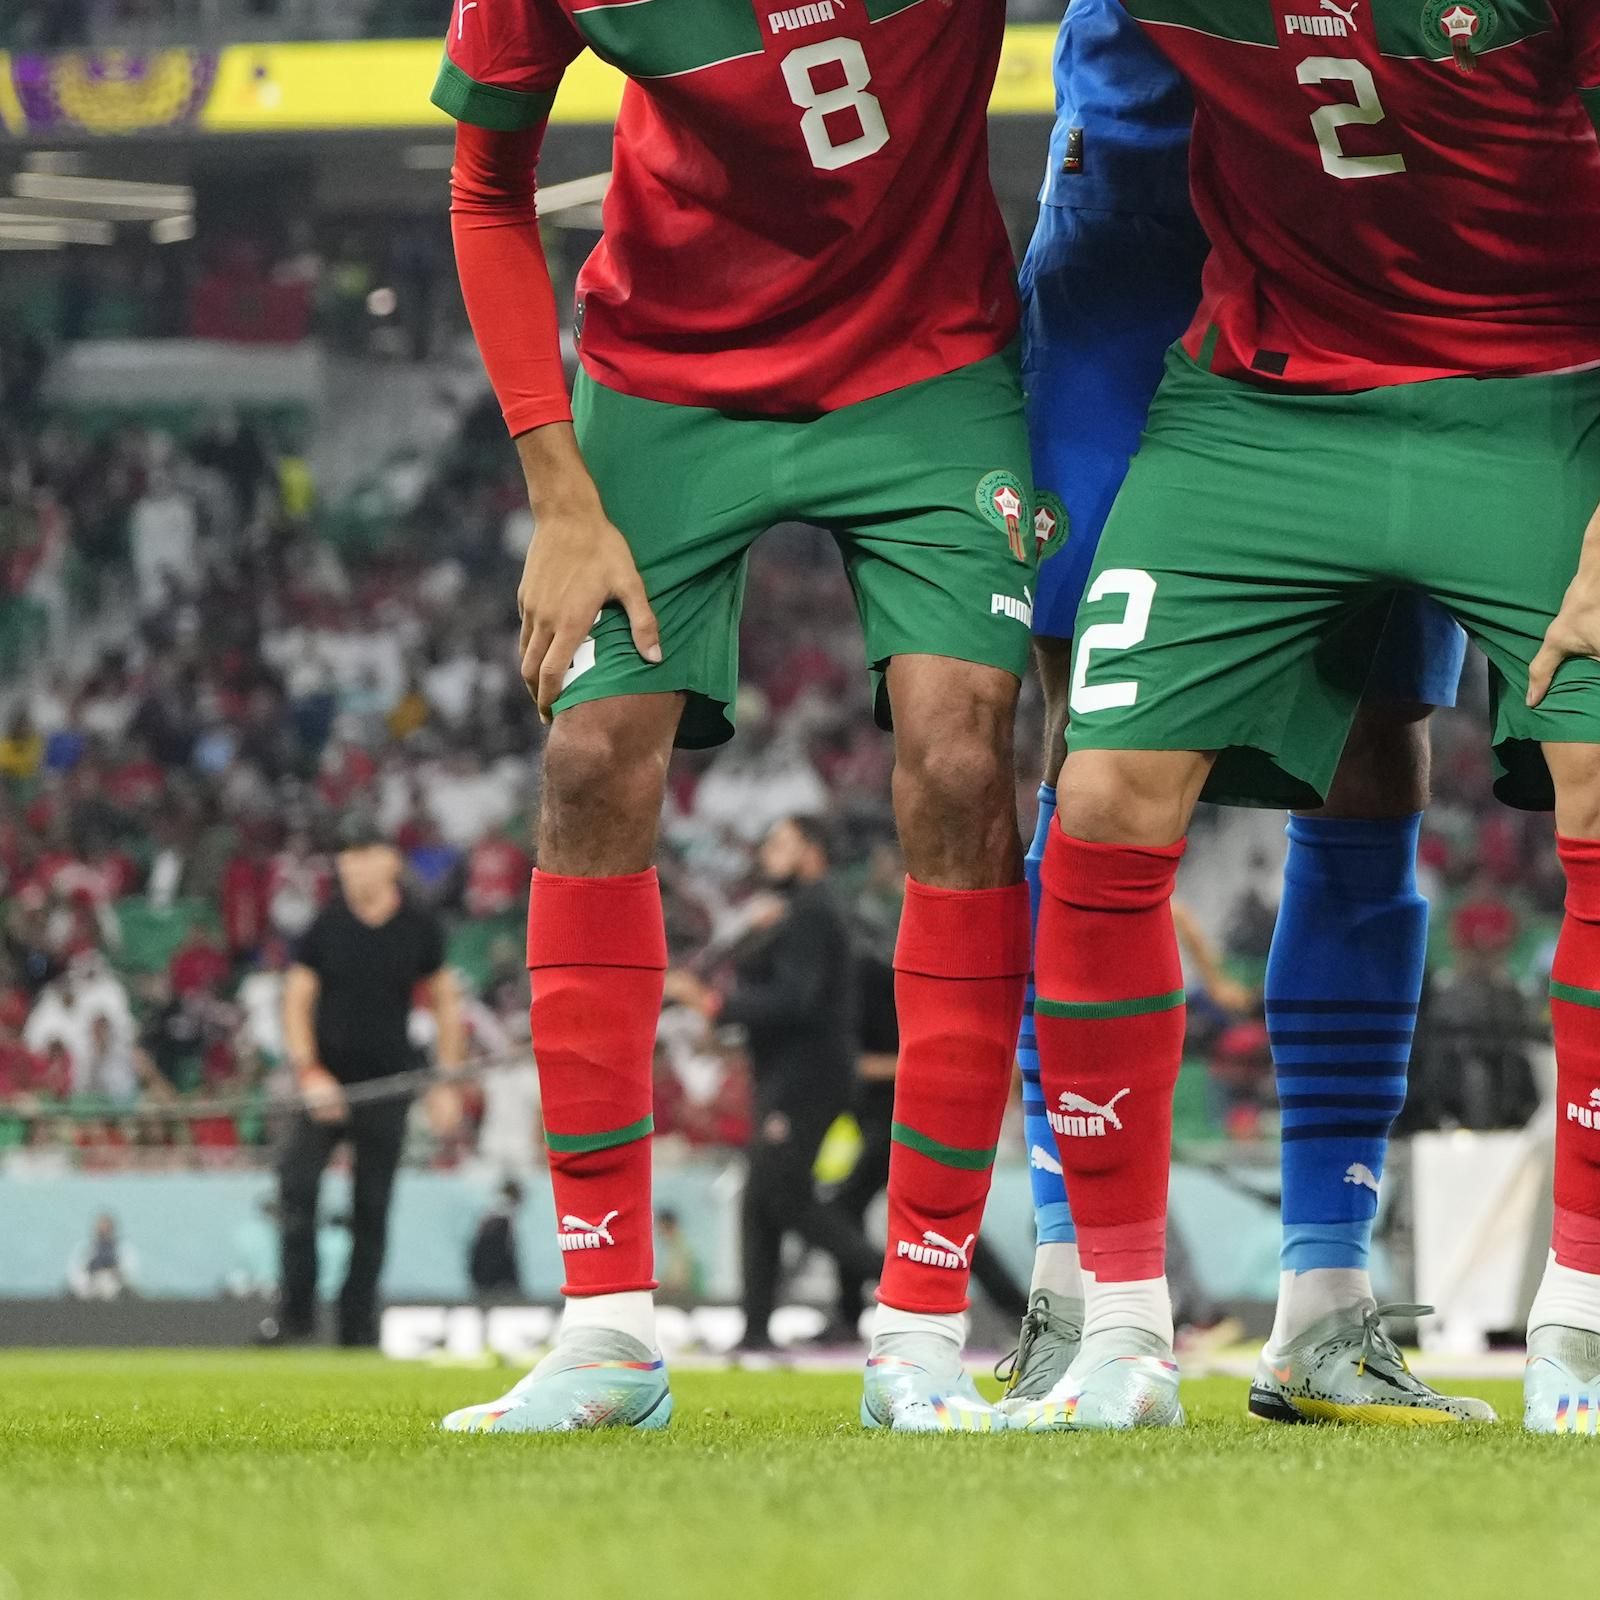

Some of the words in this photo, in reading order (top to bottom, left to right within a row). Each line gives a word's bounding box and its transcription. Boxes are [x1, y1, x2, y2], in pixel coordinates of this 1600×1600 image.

[768, 0, 835, 34] PUMA
[1285, 14, 1348, 37] PUMA
[781, 37, 890, 171] 8
[1296, 56, 1406, 179] 2
[1070, 569, 1157, 715] 2
[897, 1240, 960, 1270] PUMA
